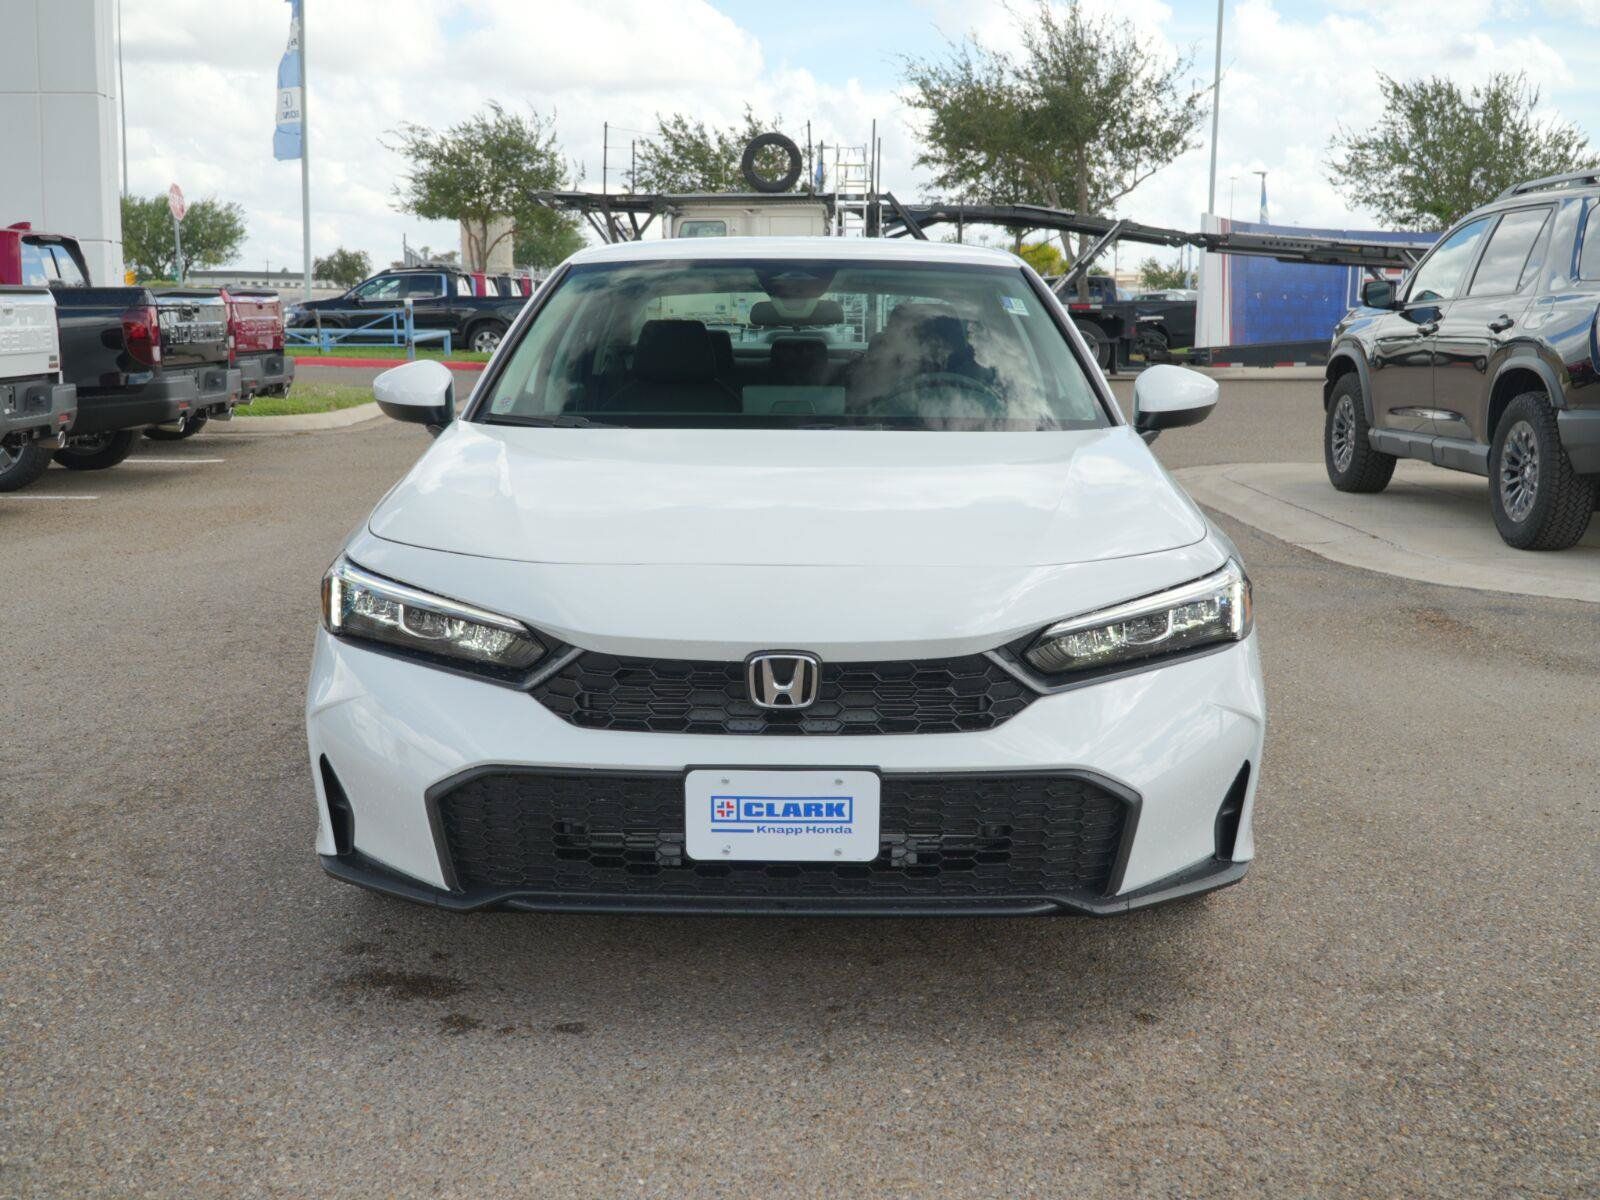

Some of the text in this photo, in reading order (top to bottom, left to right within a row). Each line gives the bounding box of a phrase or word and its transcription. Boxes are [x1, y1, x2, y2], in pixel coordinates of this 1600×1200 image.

[743, 802, 846, 818] CLARK
[756, 825, 852, 836] Knapp Honda
